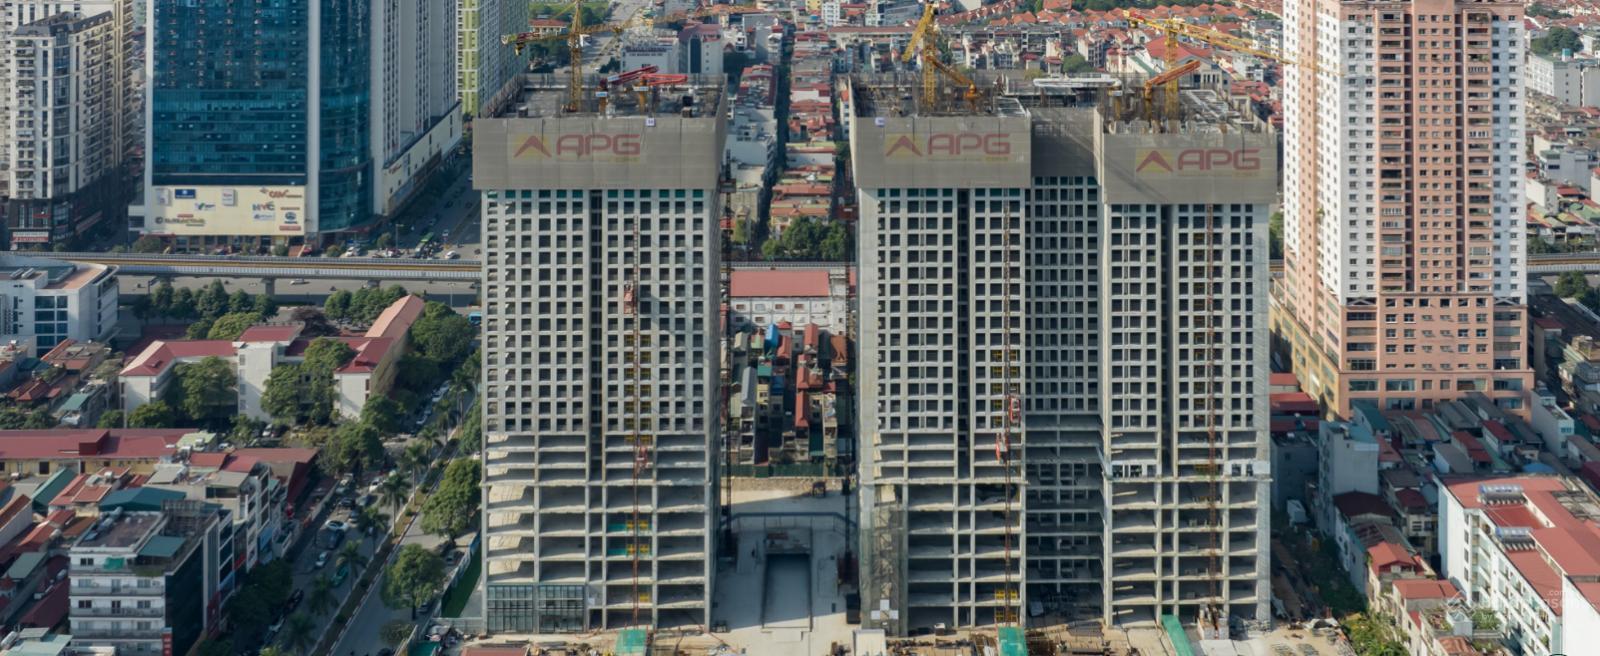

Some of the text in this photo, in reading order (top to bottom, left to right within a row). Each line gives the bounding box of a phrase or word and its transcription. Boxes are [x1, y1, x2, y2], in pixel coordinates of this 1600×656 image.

[557, 134, 640, 155] APG
[928, 133, 1010, 155] APG
[1178, 149, 1261, 170] APG
